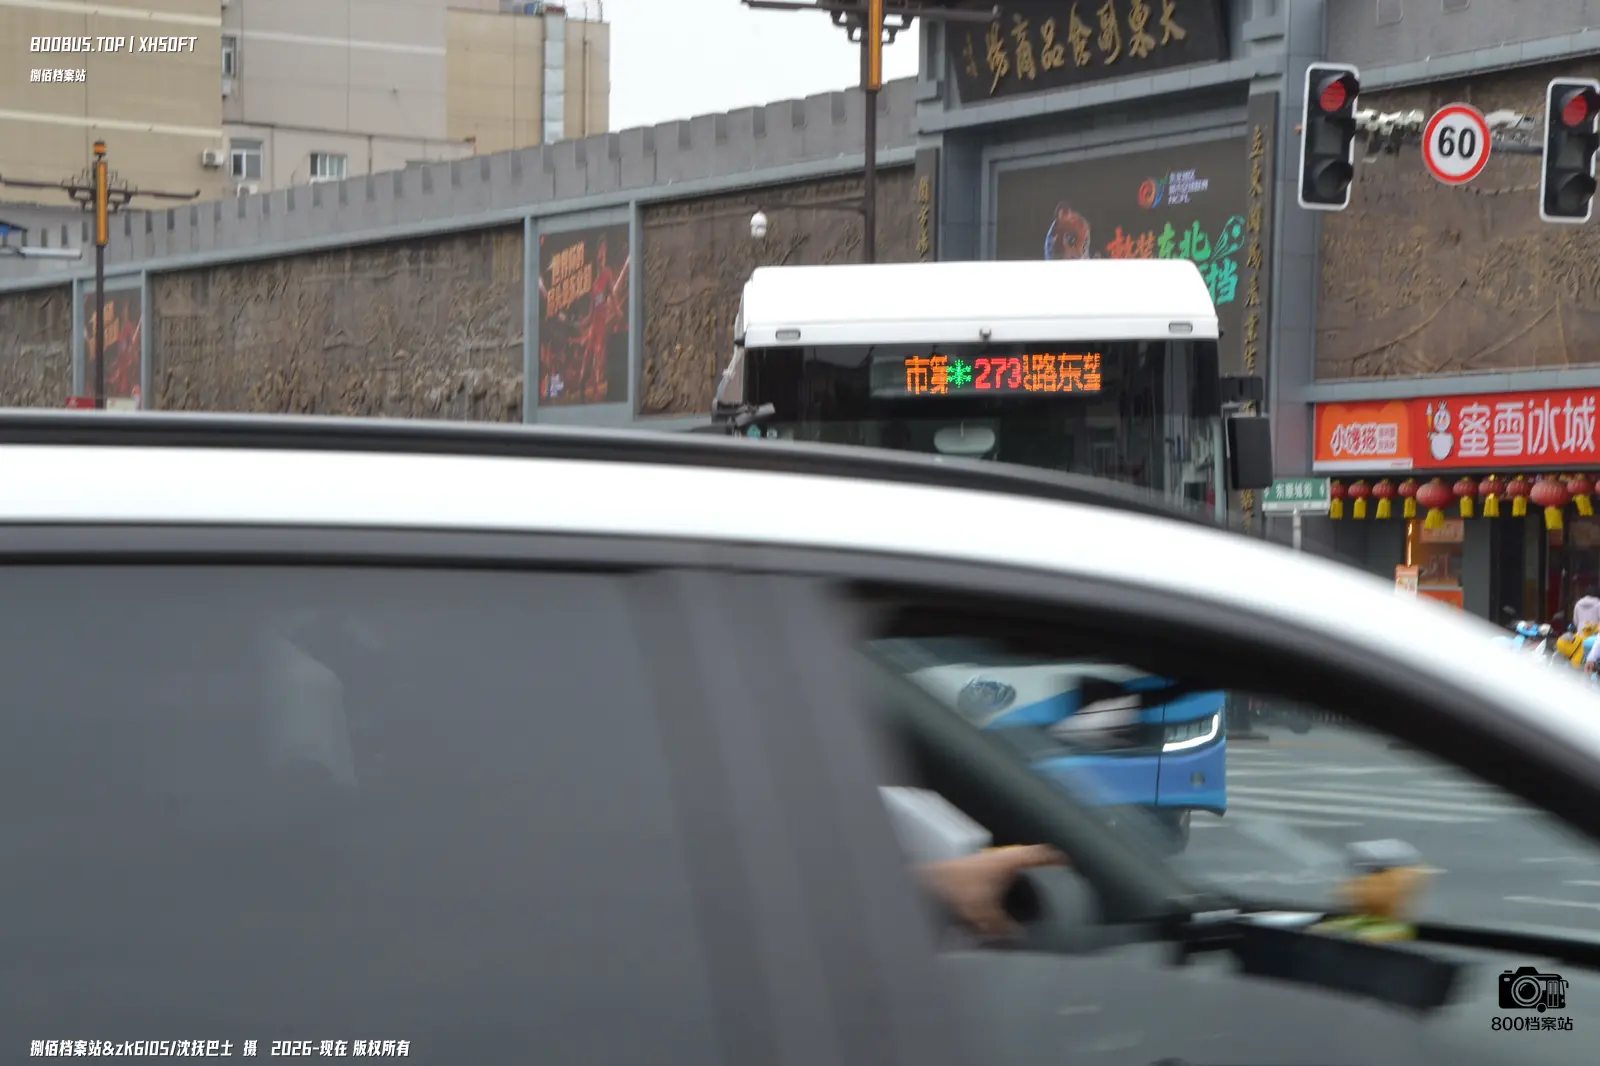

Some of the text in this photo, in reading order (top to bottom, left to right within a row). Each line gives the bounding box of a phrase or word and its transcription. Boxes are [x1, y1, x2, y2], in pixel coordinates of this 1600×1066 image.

[1438, 125, 1476, 159] 60
[974, 357, 1022, 390] 273
[1457, 395, 1596, 458] 蜜雪冰城
